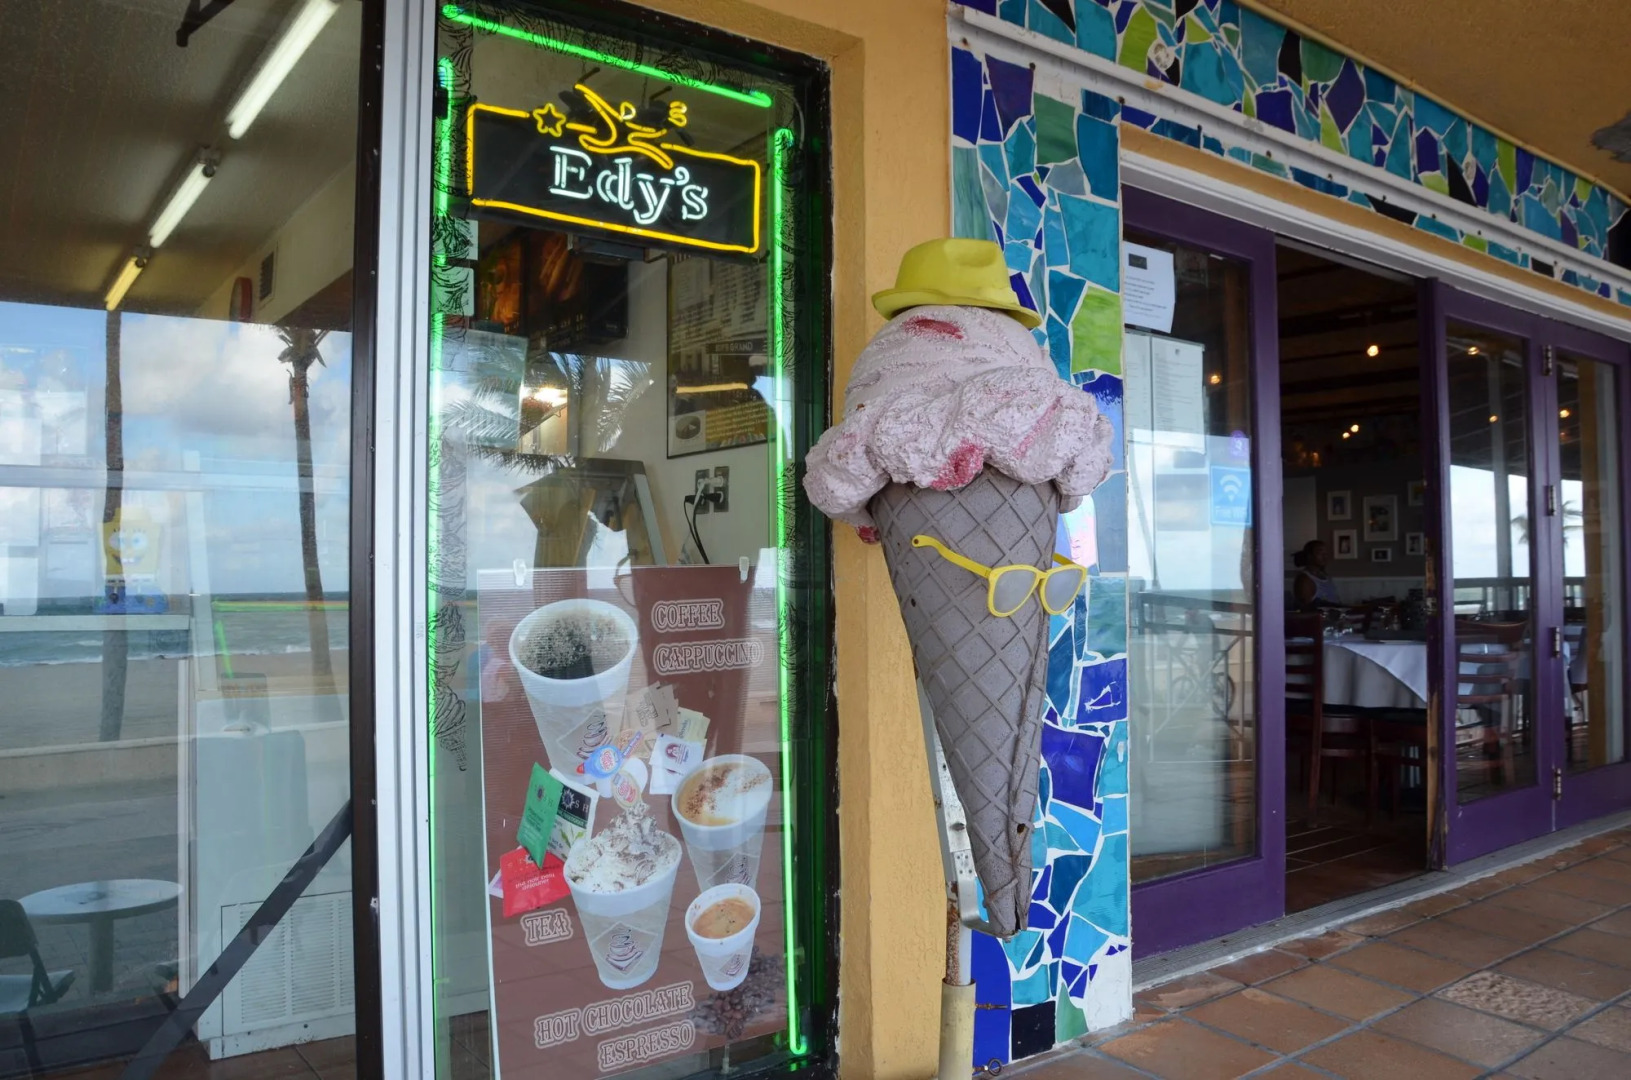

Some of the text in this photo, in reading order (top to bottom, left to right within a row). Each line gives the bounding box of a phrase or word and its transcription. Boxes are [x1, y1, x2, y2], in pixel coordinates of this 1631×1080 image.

[549, 145, 709, 225] Edy's
[655, 602, 721, 629] COFFEE
[655, 641, 762, 673] CAPPUCCINO
[525, 912, 569, 941] TEA
[537, 984, 692, 1045] HOT CHOCOLATE
[600, 1024, 693, 1068] ESPRESSO
